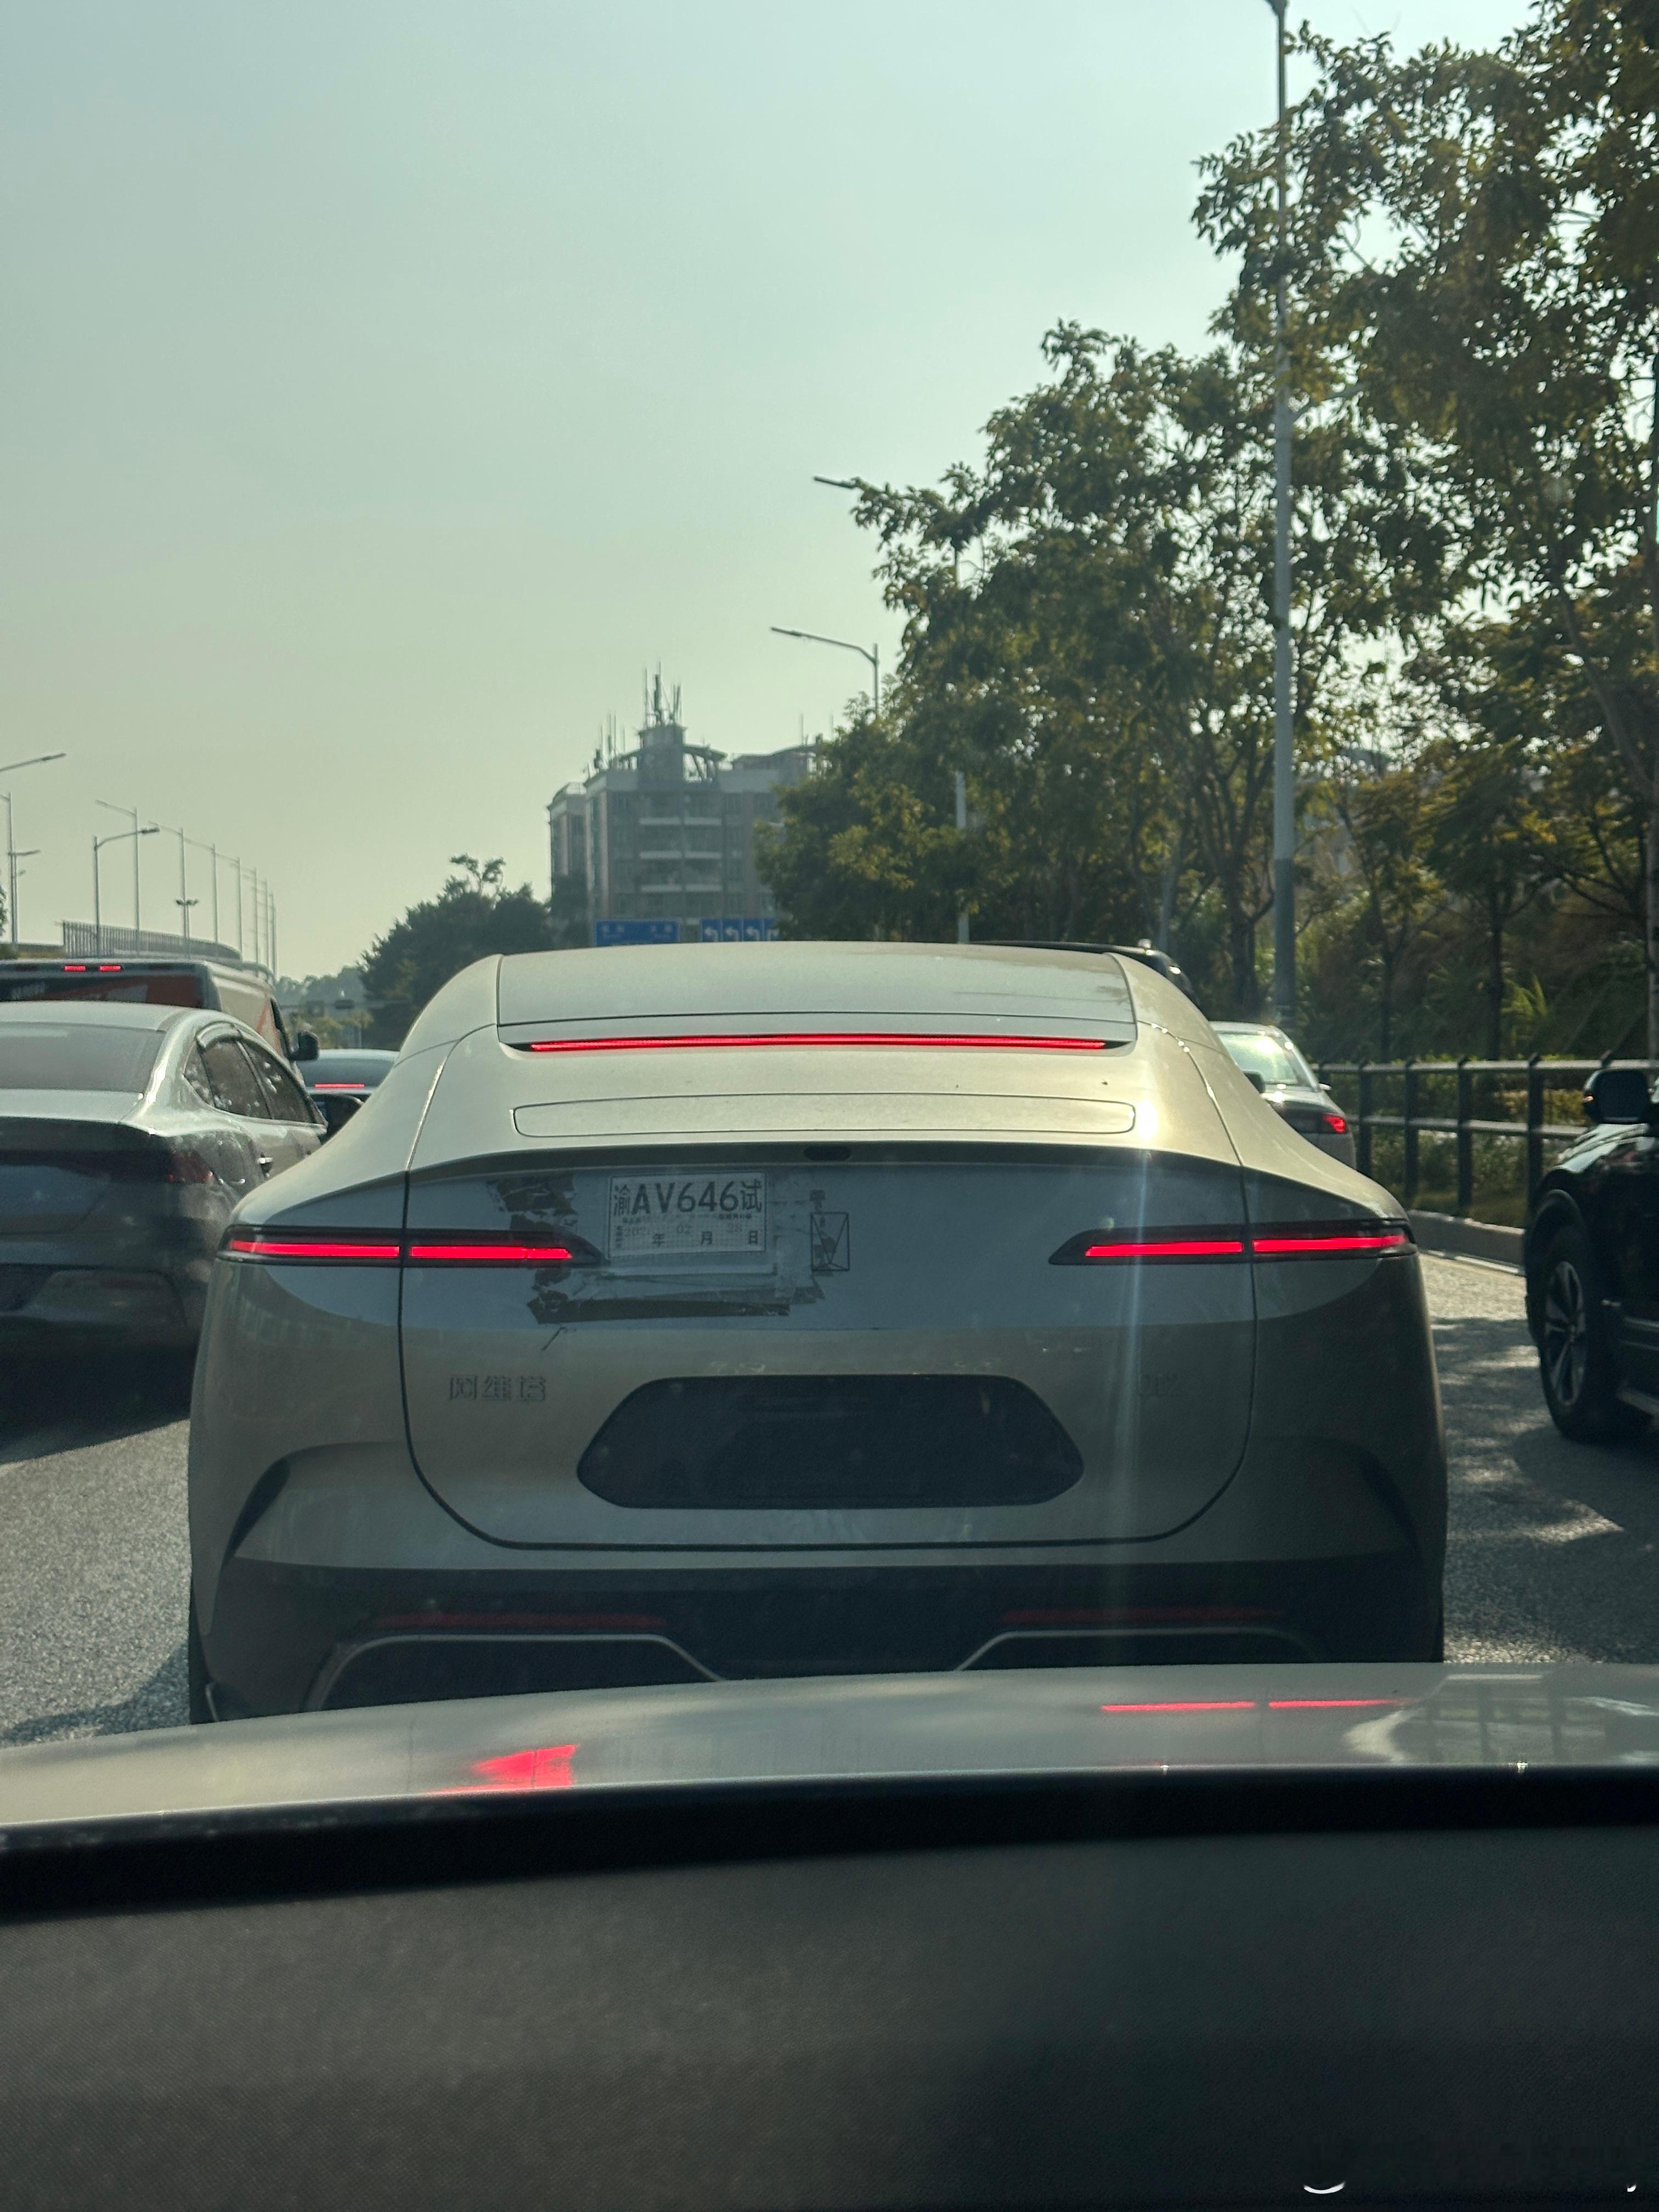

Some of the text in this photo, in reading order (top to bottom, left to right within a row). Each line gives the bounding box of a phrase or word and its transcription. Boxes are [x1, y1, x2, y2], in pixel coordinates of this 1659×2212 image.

[614, 1179, 762, 1215] 渝AV646试
[652, 1233, 665, 1246] 年
[701, 1231, 713, 1245] 月
[748, 1230, 758, 1245] 日
